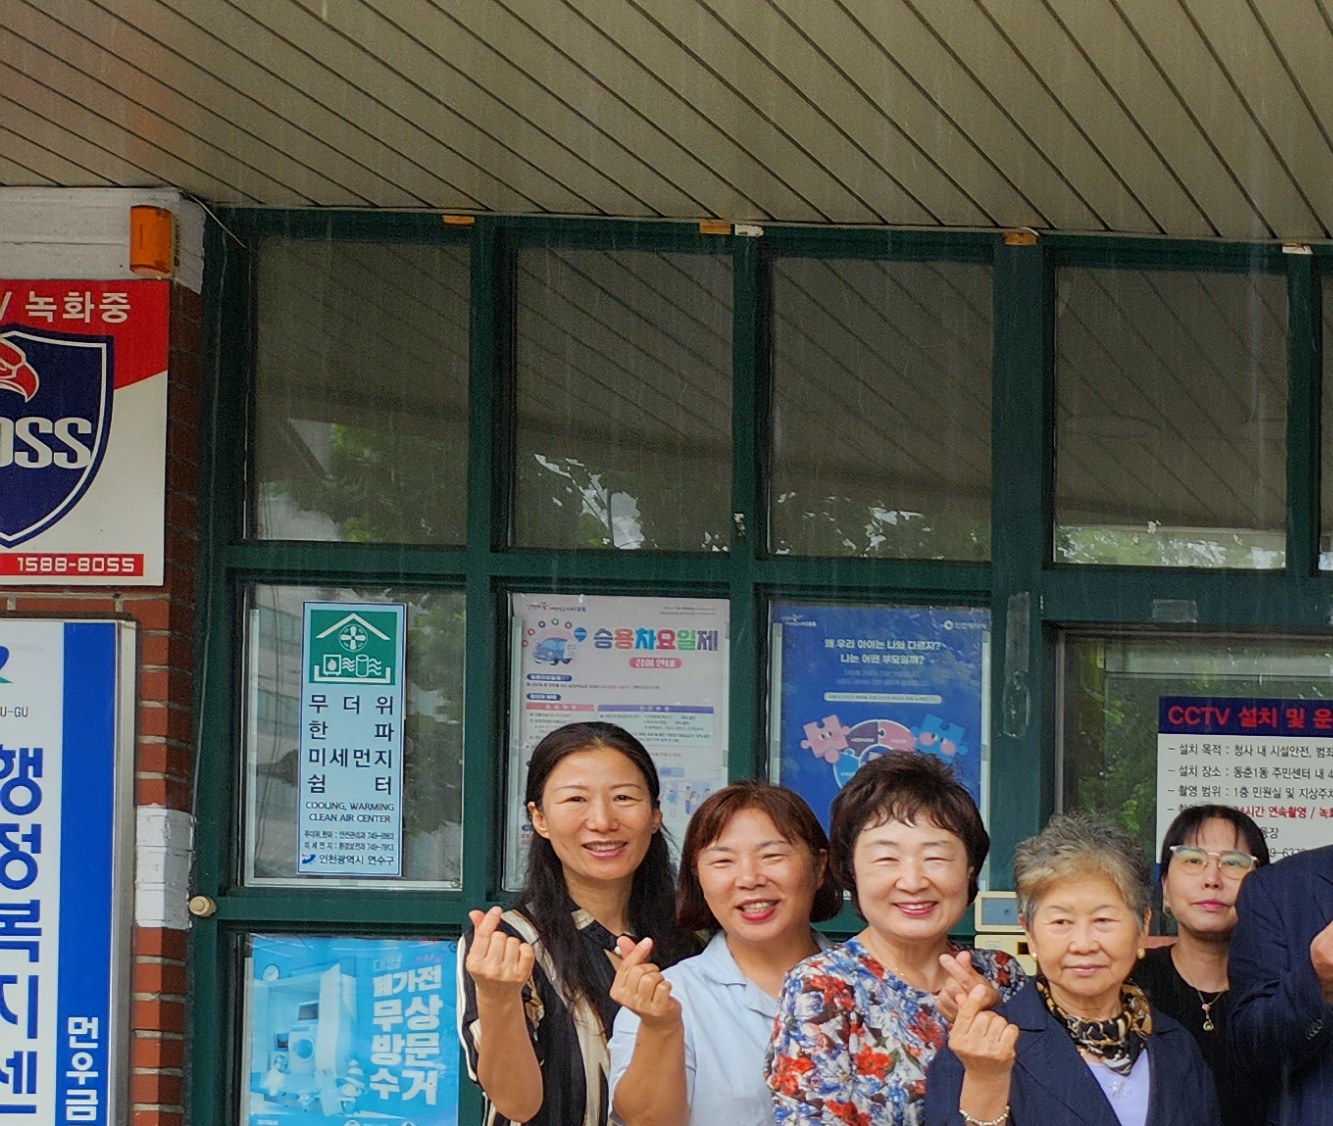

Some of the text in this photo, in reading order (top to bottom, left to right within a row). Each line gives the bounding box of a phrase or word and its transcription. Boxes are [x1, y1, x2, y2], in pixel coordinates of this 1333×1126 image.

[25, 290, 131, 323] 녹화중
[17, 556, 135, 573] 1588-8055
[593, 627, 718, 652] 승용차요일제
[836, 639, 855, 649] 우리
[857, 639, 885, 649] 아이는
[840, 653, 859, 663] 나는
[1167, 705, 1231, 726] CCTV
[1238, 706, 1278, 729] 설치
[1286, 708, 1305, 729] 및
[308, 748, 392, 769] 미세먼지
[1178, 743, 1198, 756] 설치
[1202, 743, 1222, 757] 목적
[1233, 744, 1254, 757] 청사
[1257, 746, 1267, 757] 내
[1270, 745, 1313, 759] 시설안전,
[1178, 765, 1324, 781] 설치 장소 동춘1동 주민센터 내
[1178, 785, 1198, 798] 촬영
[1201, 785, 1222, 798] 범위
[1233, 786, 1249, 799] 1층
[1252, 786, 1282, 799] 민원실
[1285, 787, 1295, 799] 및
[350, 802, 395, 811] WARMING
[1268, 806, 1307, 820] 연속촬영
[309, 814, 391, 823] CLEAN AIR CENTER
[319, 854, 395, 866] 인천광역시 연수구
[372, 994, 443, 1033] 무상
[370, 1032, 440, 1067] 방문
[369, 1069, 438, 1106] 수거
